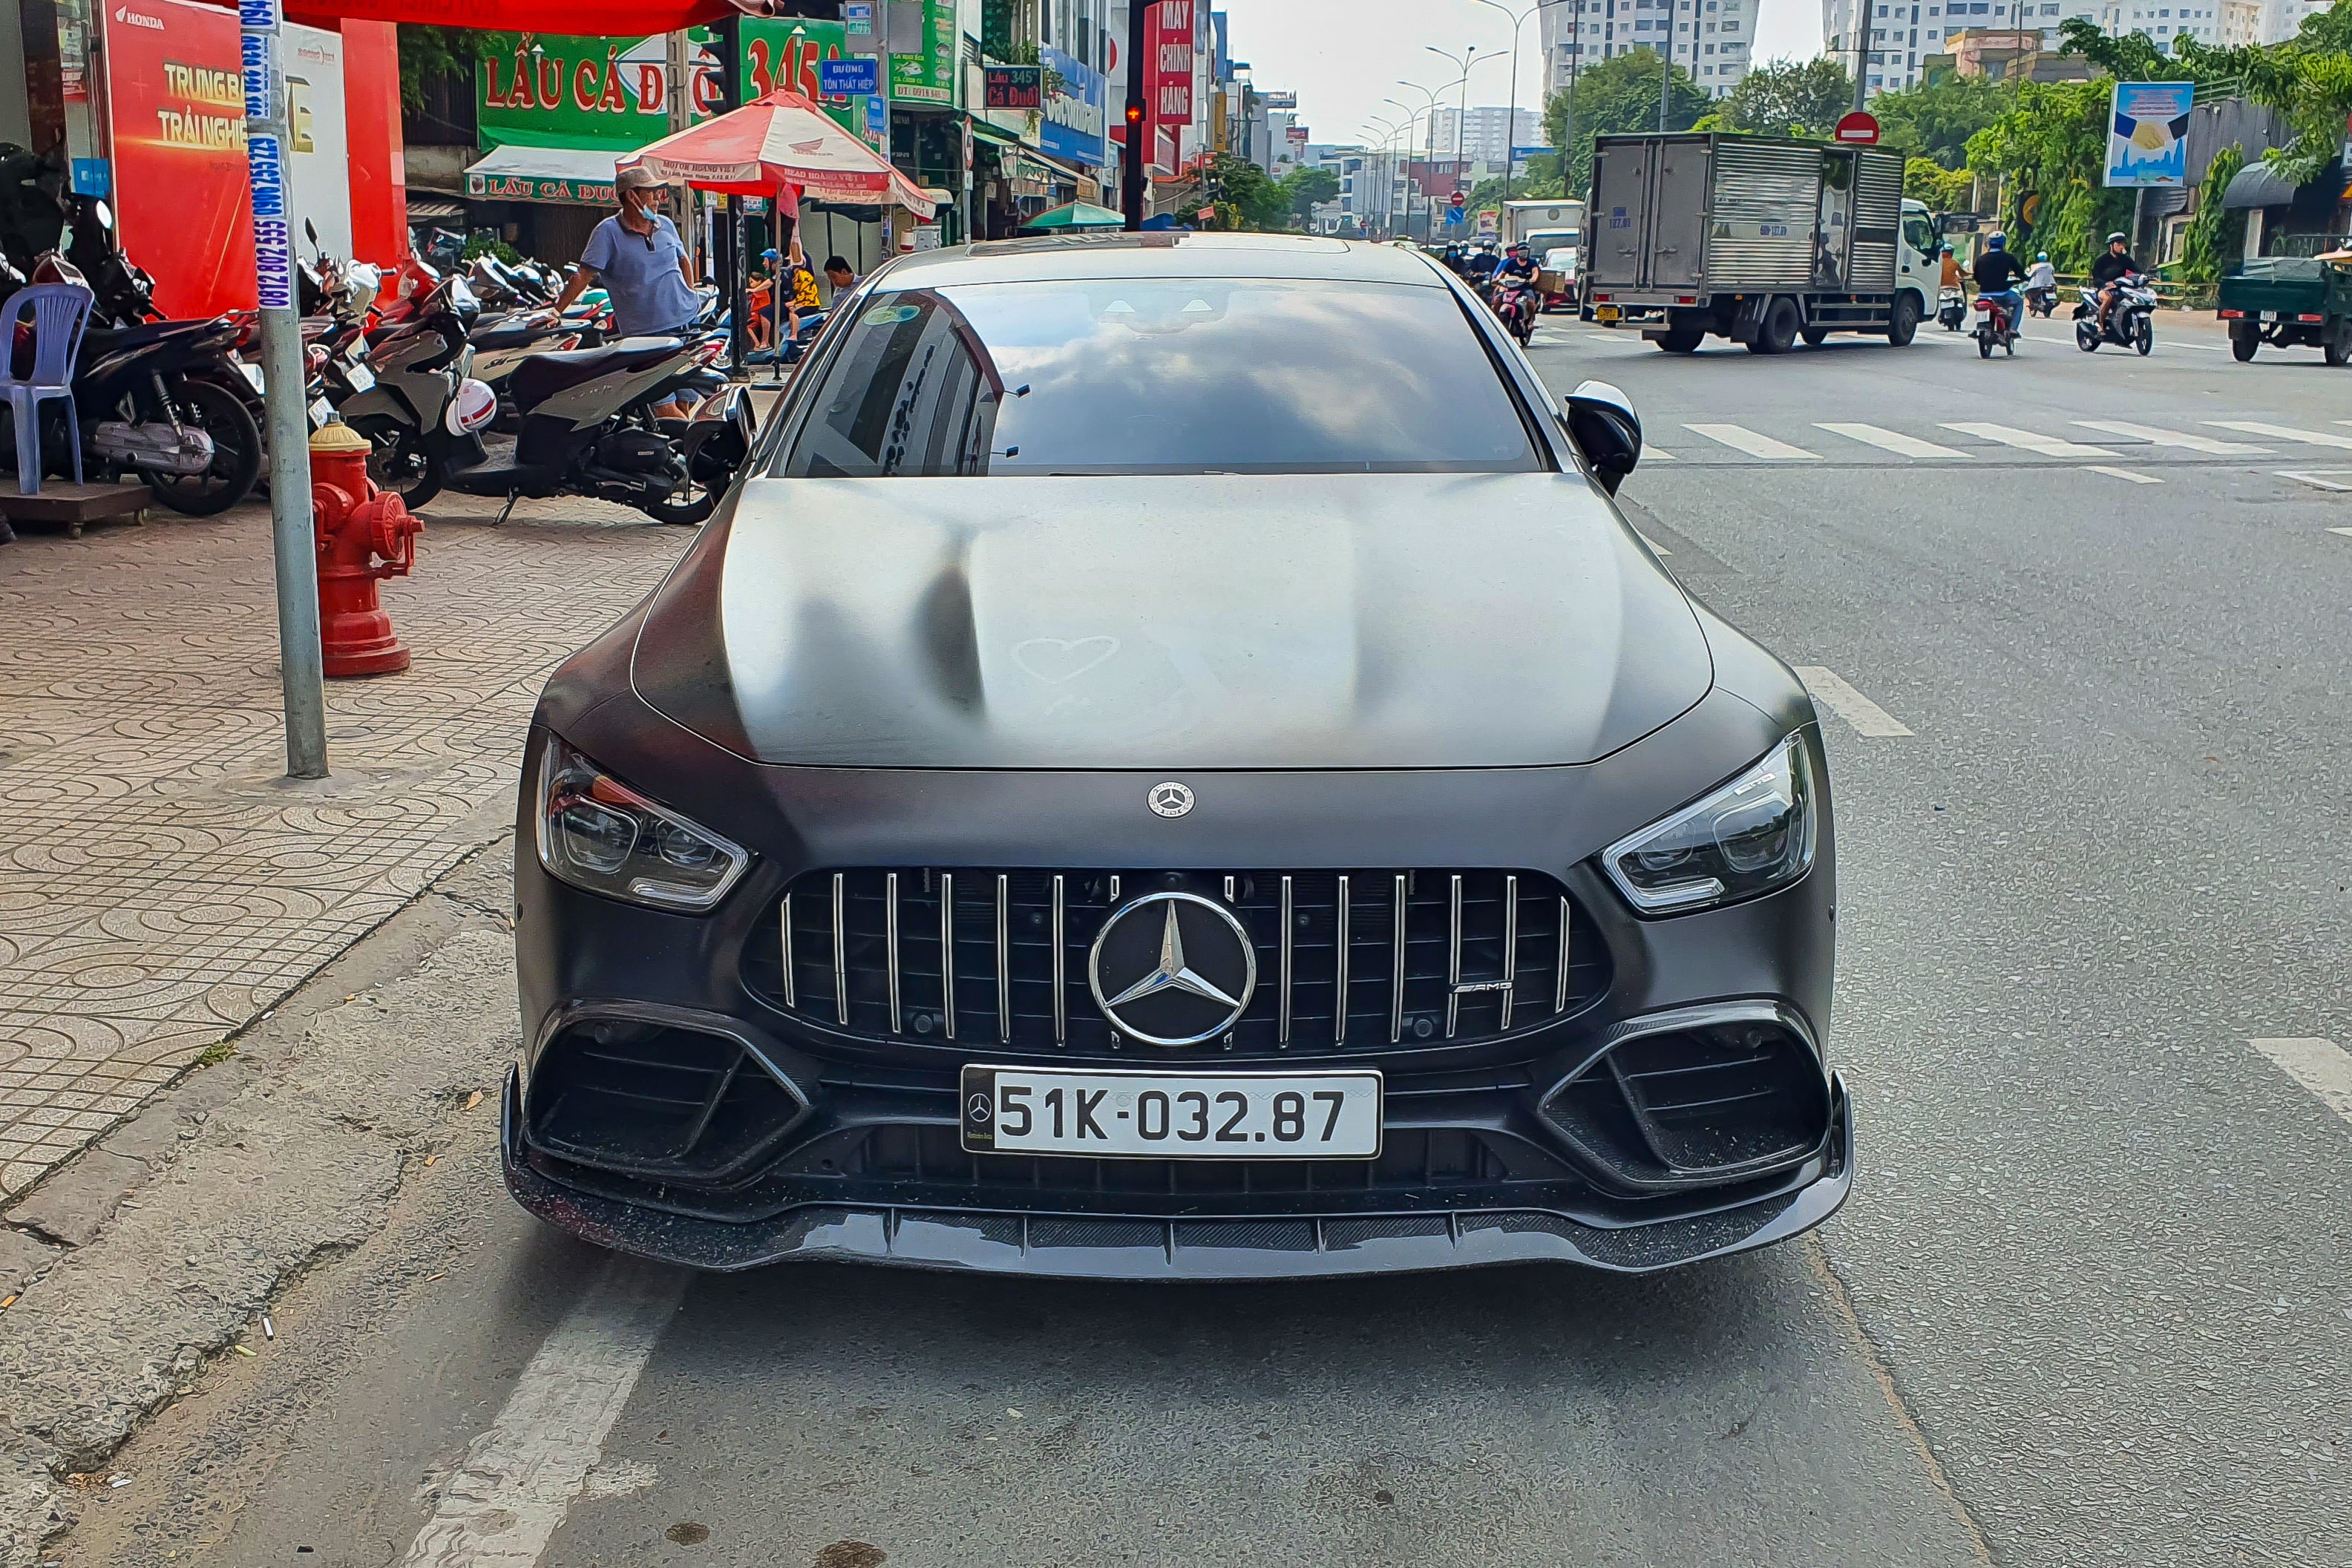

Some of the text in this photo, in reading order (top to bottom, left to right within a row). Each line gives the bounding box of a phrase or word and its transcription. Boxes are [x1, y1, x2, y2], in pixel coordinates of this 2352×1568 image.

[126, 13, 166, 30] HONDA
[1160, 37, 1190, 72] CHÍNH
[573, 45, 627, 113] CÁ
[823, 79, 837, 90] TÔN
[839, 76, 856, 90] THẤT
[987, 86, 1004, 105] Cá
[158, 105, 248, 152] TRẢI NGHIỆ
[540, 181, 571, 198] CÁ
[254, 220, 289, 306] 0812.802.555
[1000, 1086, 1345, 1143] 51K-032.87
